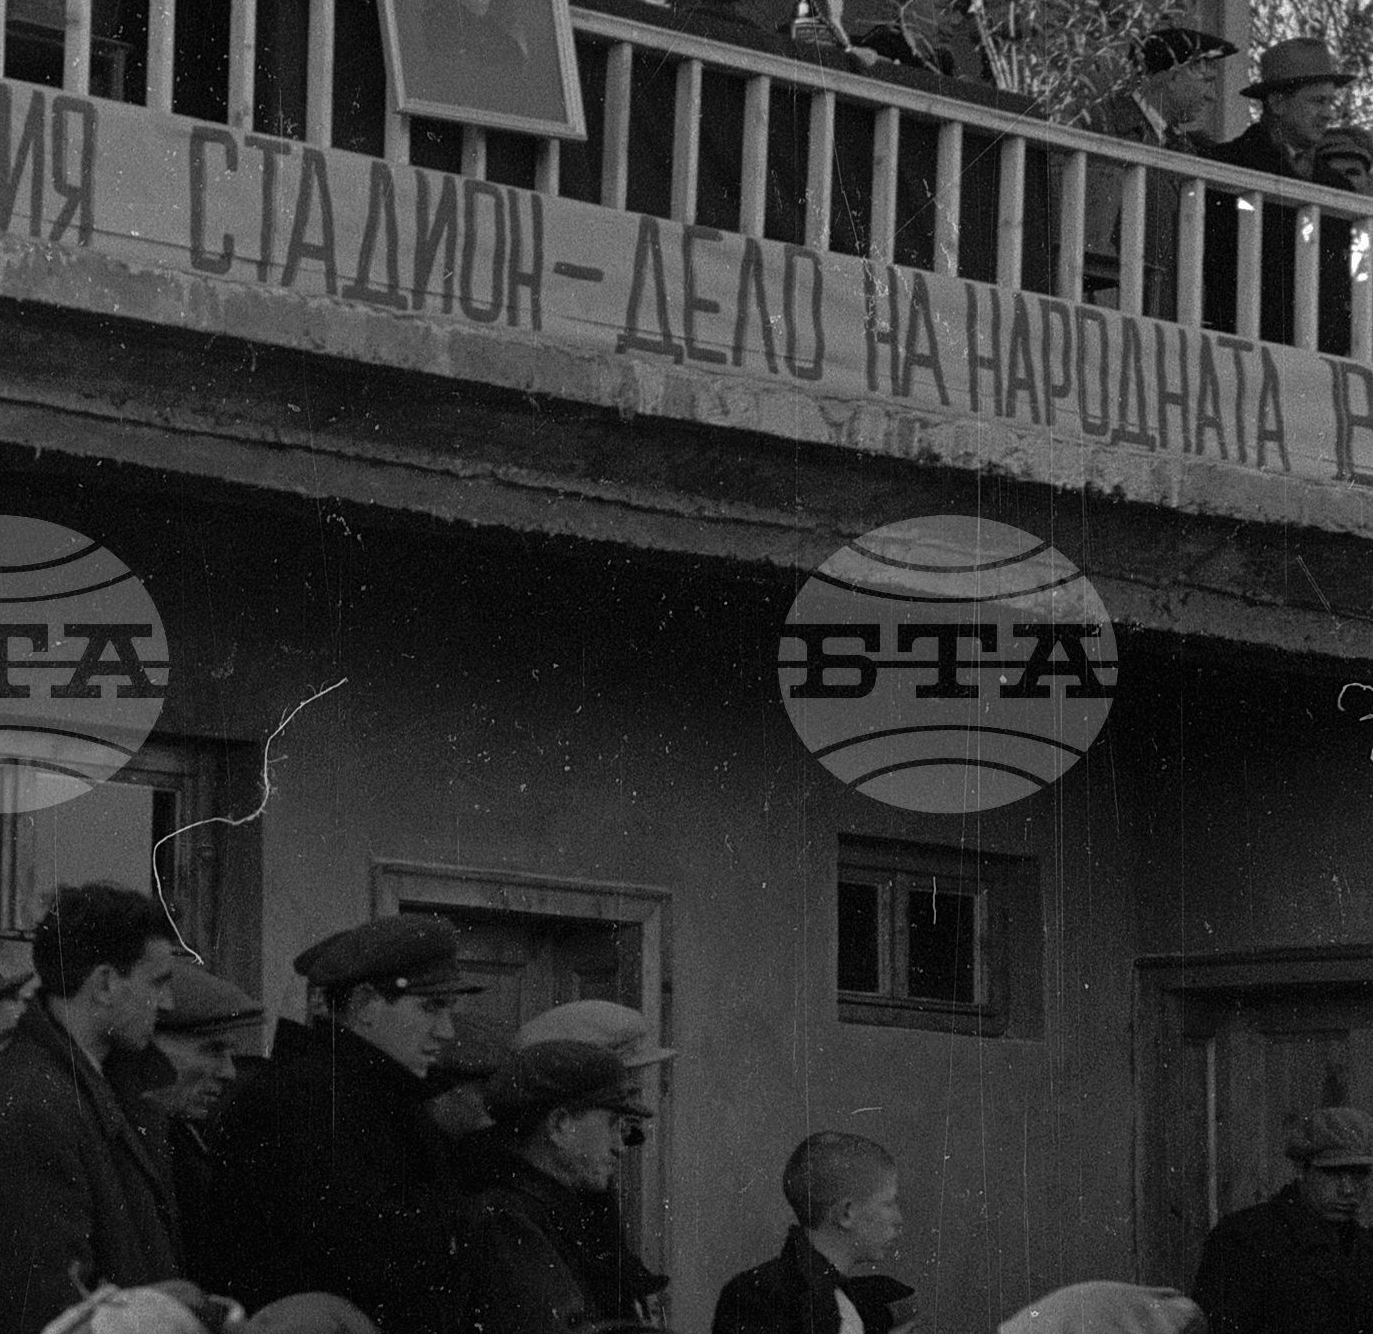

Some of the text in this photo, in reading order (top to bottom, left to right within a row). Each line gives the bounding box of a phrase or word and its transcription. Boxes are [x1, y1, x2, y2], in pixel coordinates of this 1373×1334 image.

[615, 214, 824, 382] ДЕЛО
[863, 260, 950, 407] НА
[965, 282, 1291, 472] НАРОДНАТА
